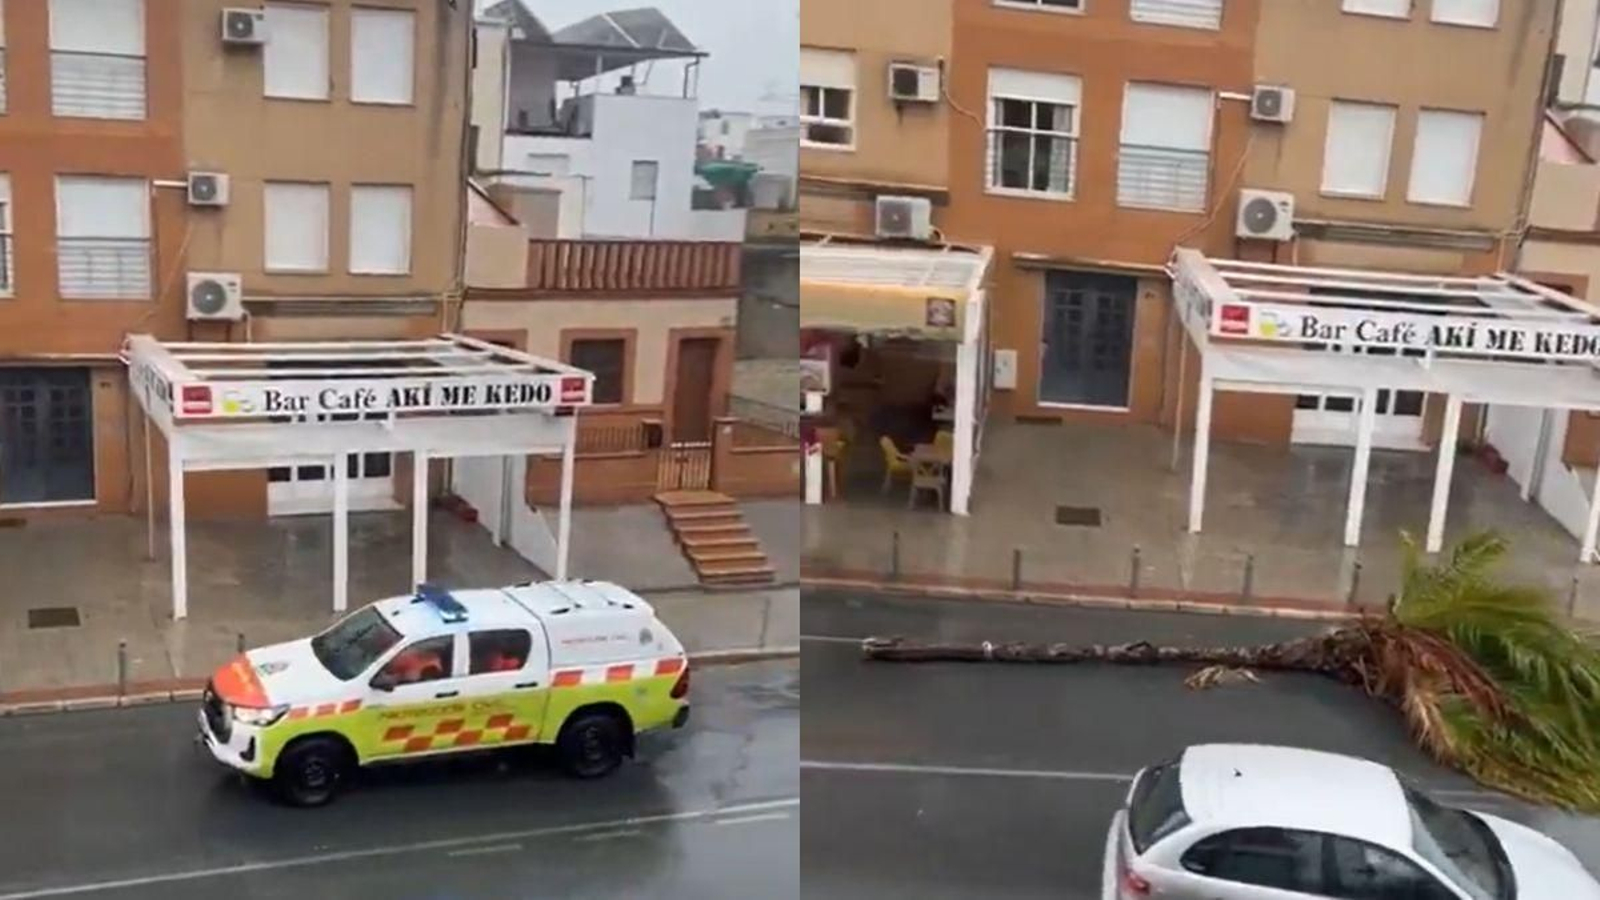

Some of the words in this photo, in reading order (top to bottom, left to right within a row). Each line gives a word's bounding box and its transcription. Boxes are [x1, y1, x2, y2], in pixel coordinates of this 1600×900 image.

[1299, 316, 1347, 339] Bar
[1356, 319, 1416, 344] Café
[1486, 329, 1526, 351] ME
[264, 390, 310, 411] Bar
[318, 388, 377, 410] Café
[441, 386, 477, 406] ME
[484, 383, 552, 405] KEDO
